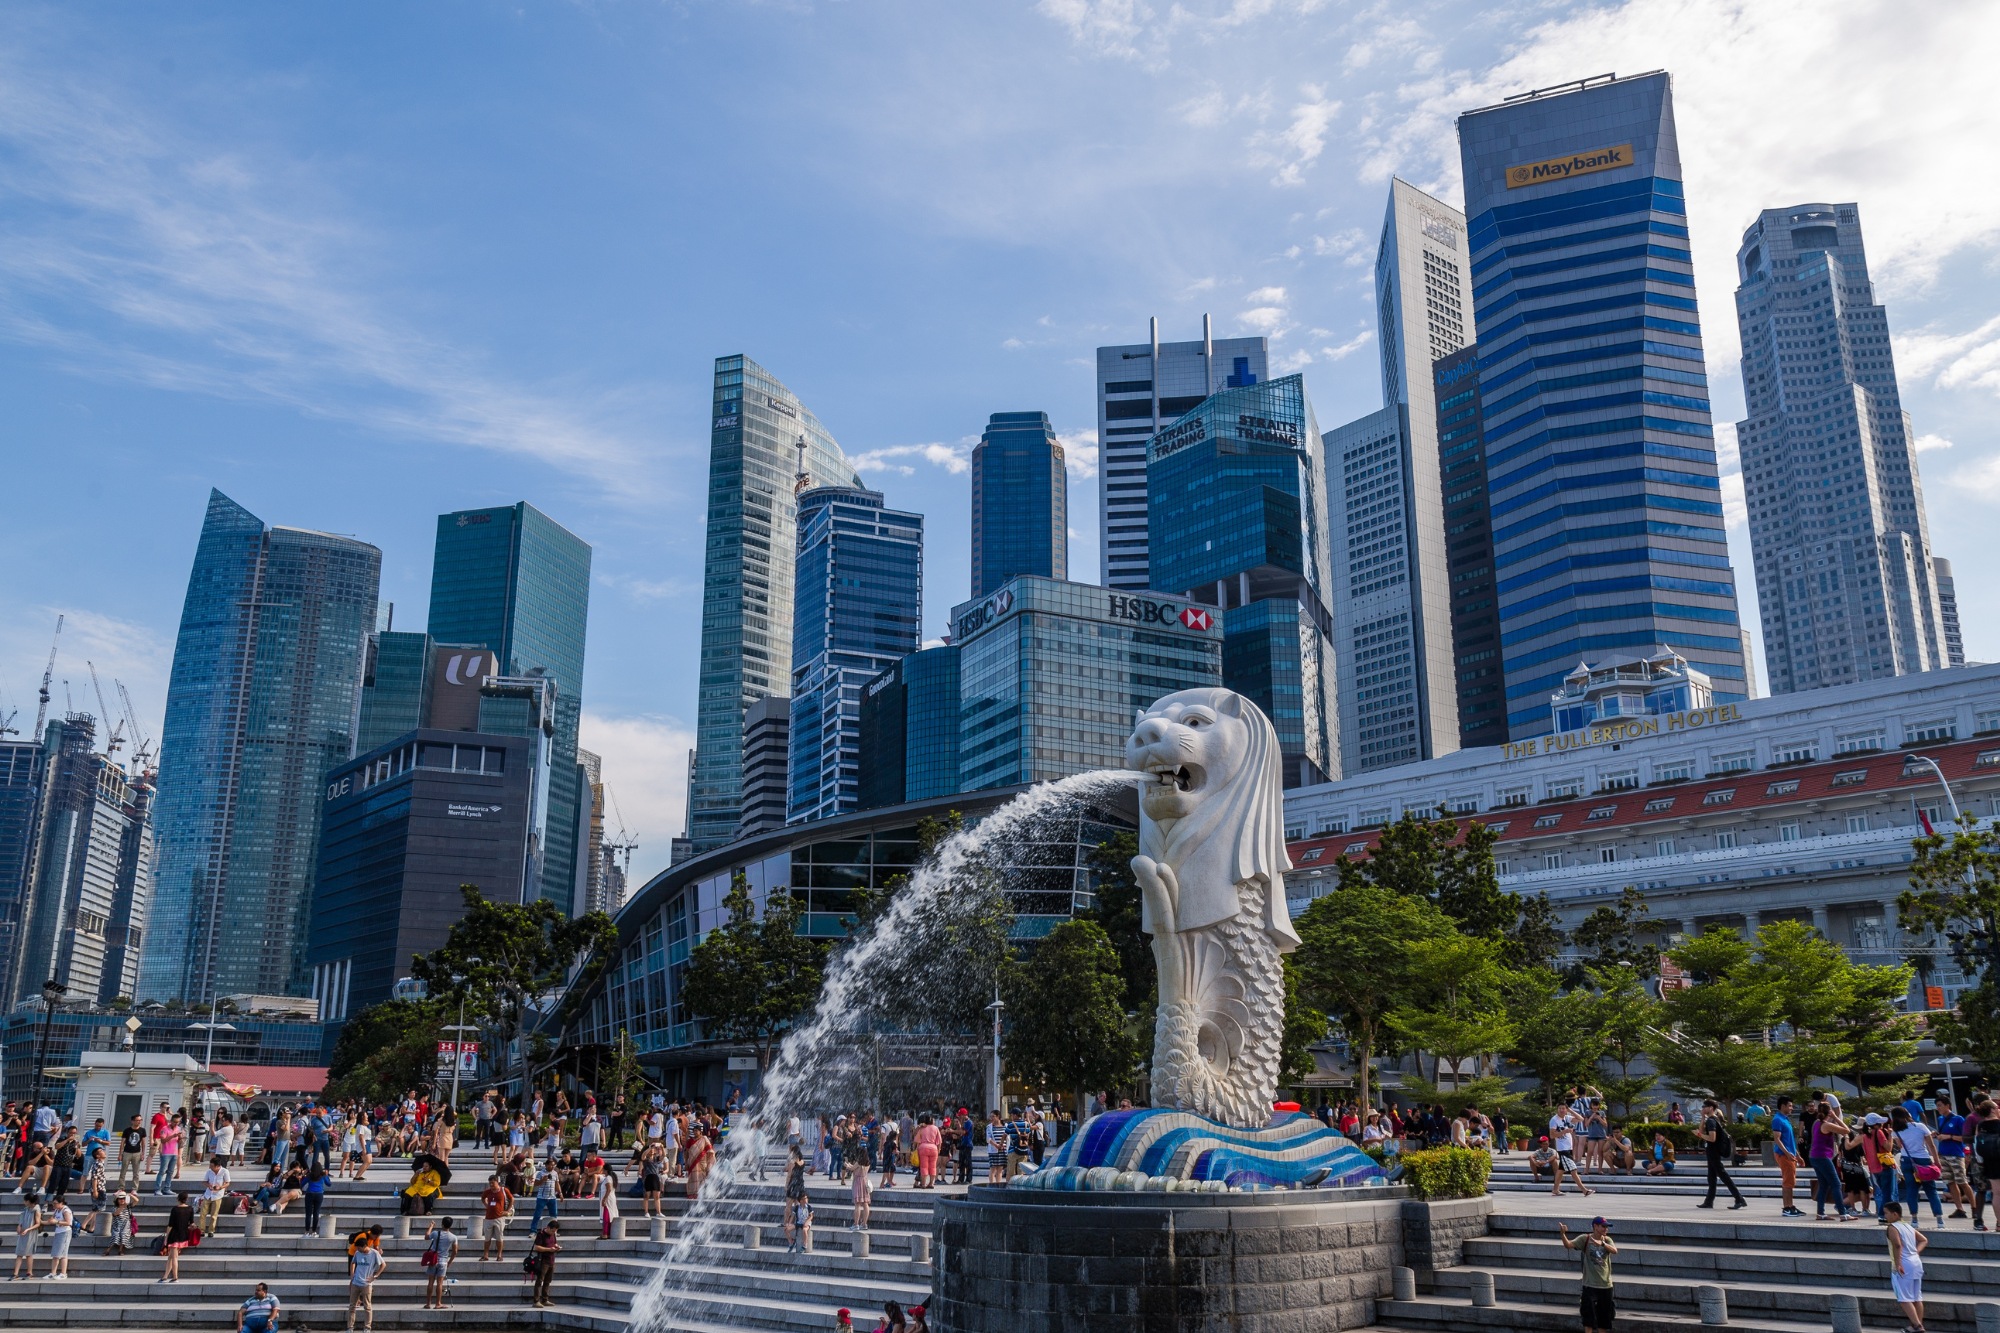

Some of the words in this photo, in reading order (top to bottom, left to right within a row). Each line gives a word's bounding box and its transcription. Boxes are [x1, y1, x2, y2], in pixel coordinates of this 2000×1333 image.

[1532, 149, 1622, 179] Maybank
[771, 399, 795, 415] Keppel
[714, 416, 738, 428] ANZ
[1154, 417, 1203, 446] STRAITS
[1238, 414, 1297, 433] STRAITS
[1154, 428, 1206, 458] TRADING
[1235, 426, 1298, 447] TRADING
[469, 513, 491, 525] UBS
[957, 600, 993, 640] HSBC
[1107, 594, 1177, 626] HSBC
[1500, 740, 1537, 759] THE
[1543, 718, 1659, 753] FULLERTON
[1667, 703, 1742, 731] HOTEL
[327, 777, 350, 801] OUE
